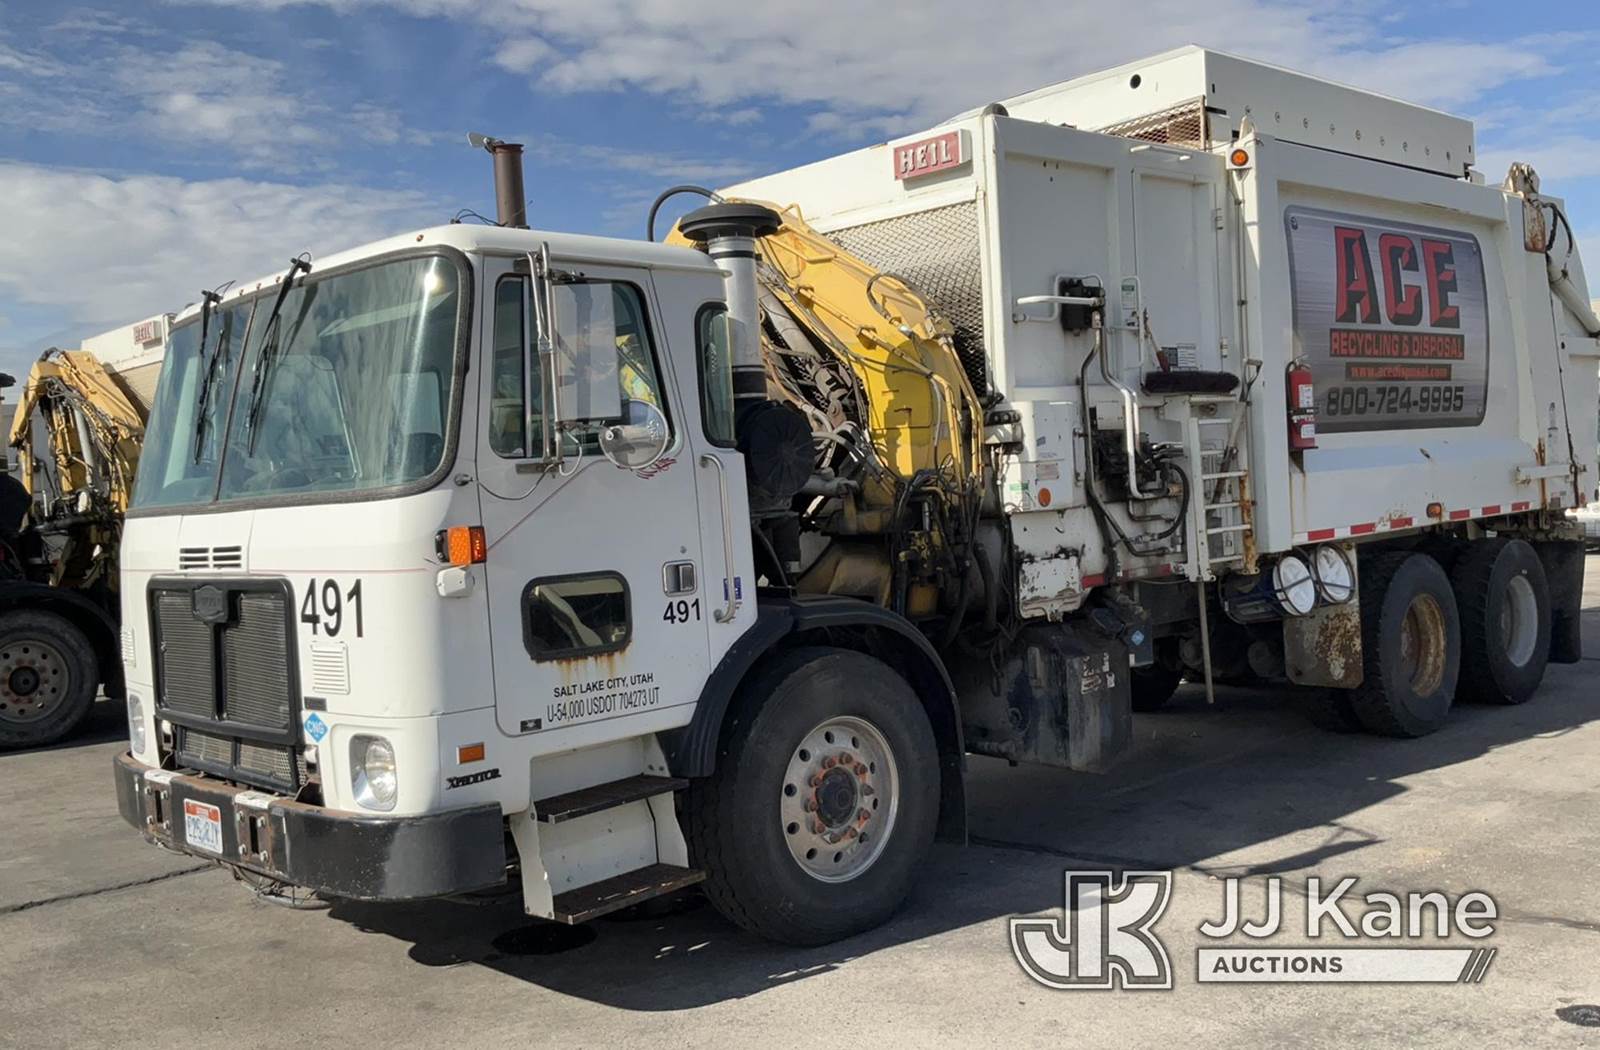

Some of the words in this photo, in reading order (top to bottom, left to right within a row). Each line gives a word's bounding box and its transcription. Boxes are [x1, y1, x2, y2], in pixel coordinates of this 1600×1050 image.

[899, 140, 952, 174] HEIL
[1334, 226, 1461, 329] ACE
[1331, 330, 1400, 357] RECYCLING
[1402, 336, 1410, 356] &
[1412, 335, 1464, 358] DISPOSAL
[1326, 385, 1465, 416] 800-724-9995
[301, 578, 363, 638] 491
[663, 598, 701, 624] 491
[553, 684, 578, 698] SALT
[580, 680, 605, 694] LAKE
[606, 676, 629, 690] CITY,
[630, 672, 654, 686] UTAH
[547, 699, 585, 723] U-54,000
[586, 694, 618, 716] USDOT
[618, 688, 648, 711] 704273
[648, 686, 661, 705] UT
